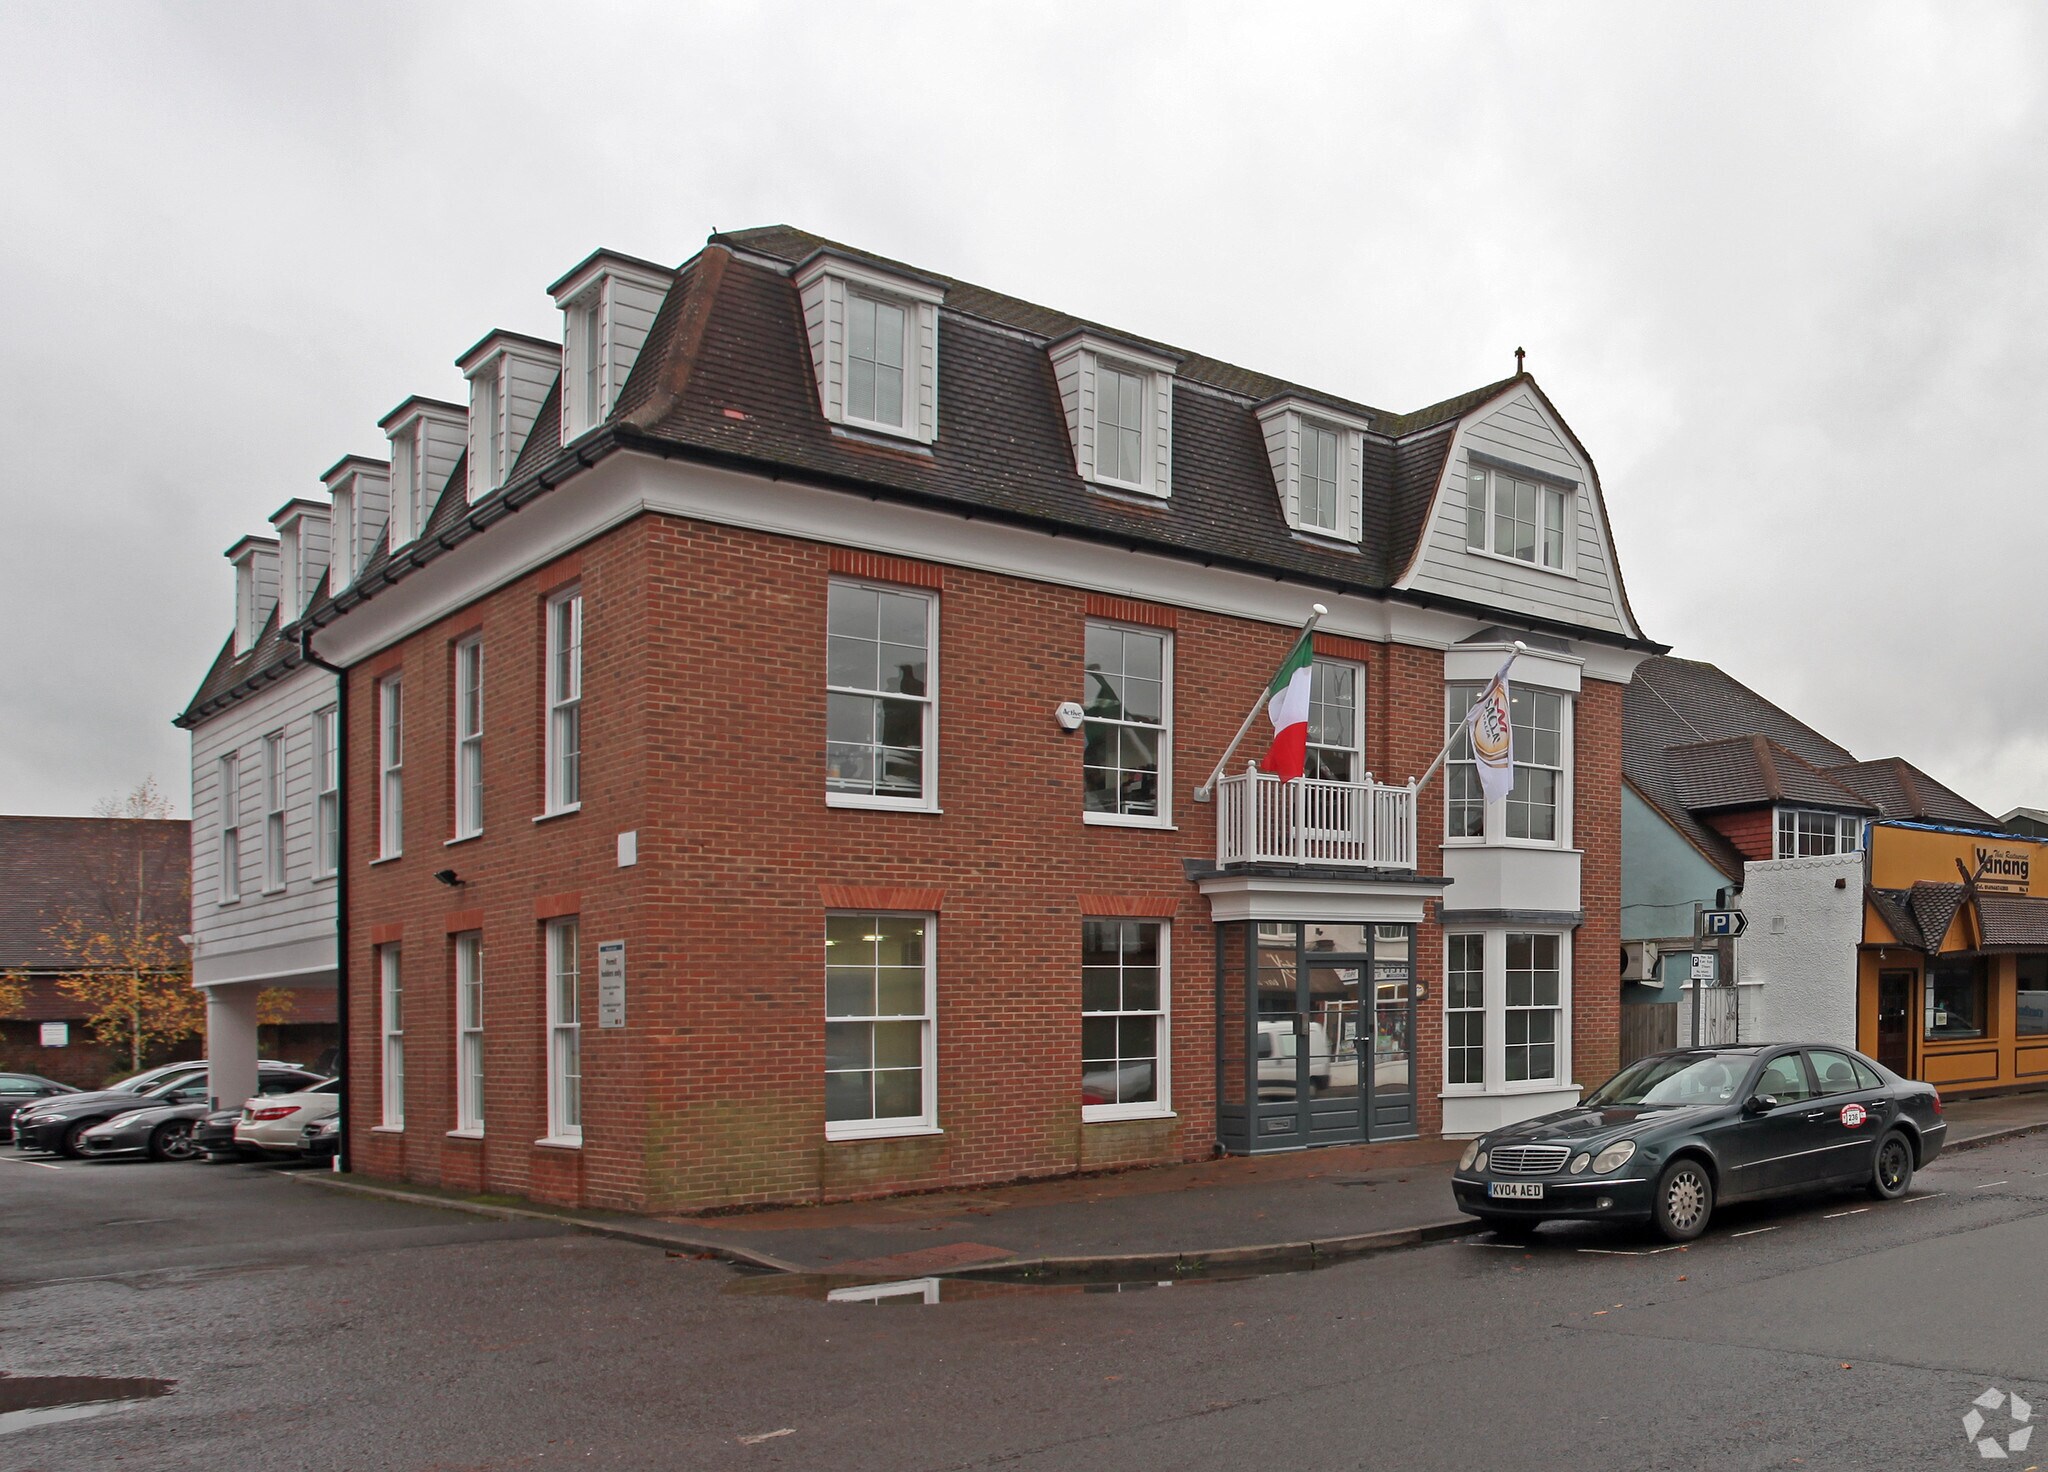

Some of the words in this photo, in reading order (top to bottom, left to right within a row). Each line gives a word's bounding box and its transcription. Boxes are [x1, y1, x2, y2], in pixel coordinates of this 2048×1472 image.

[1976, 848, 2029, 880] Yanang
[1713, 915, 1726, 932] P
[1693, 957, 1699, 966] P
[1848, 1113, 1859, 1121] 236
[1493, 1184, 1517, 1196] KV04
[1520, 1184, 1540, 1196] AED
